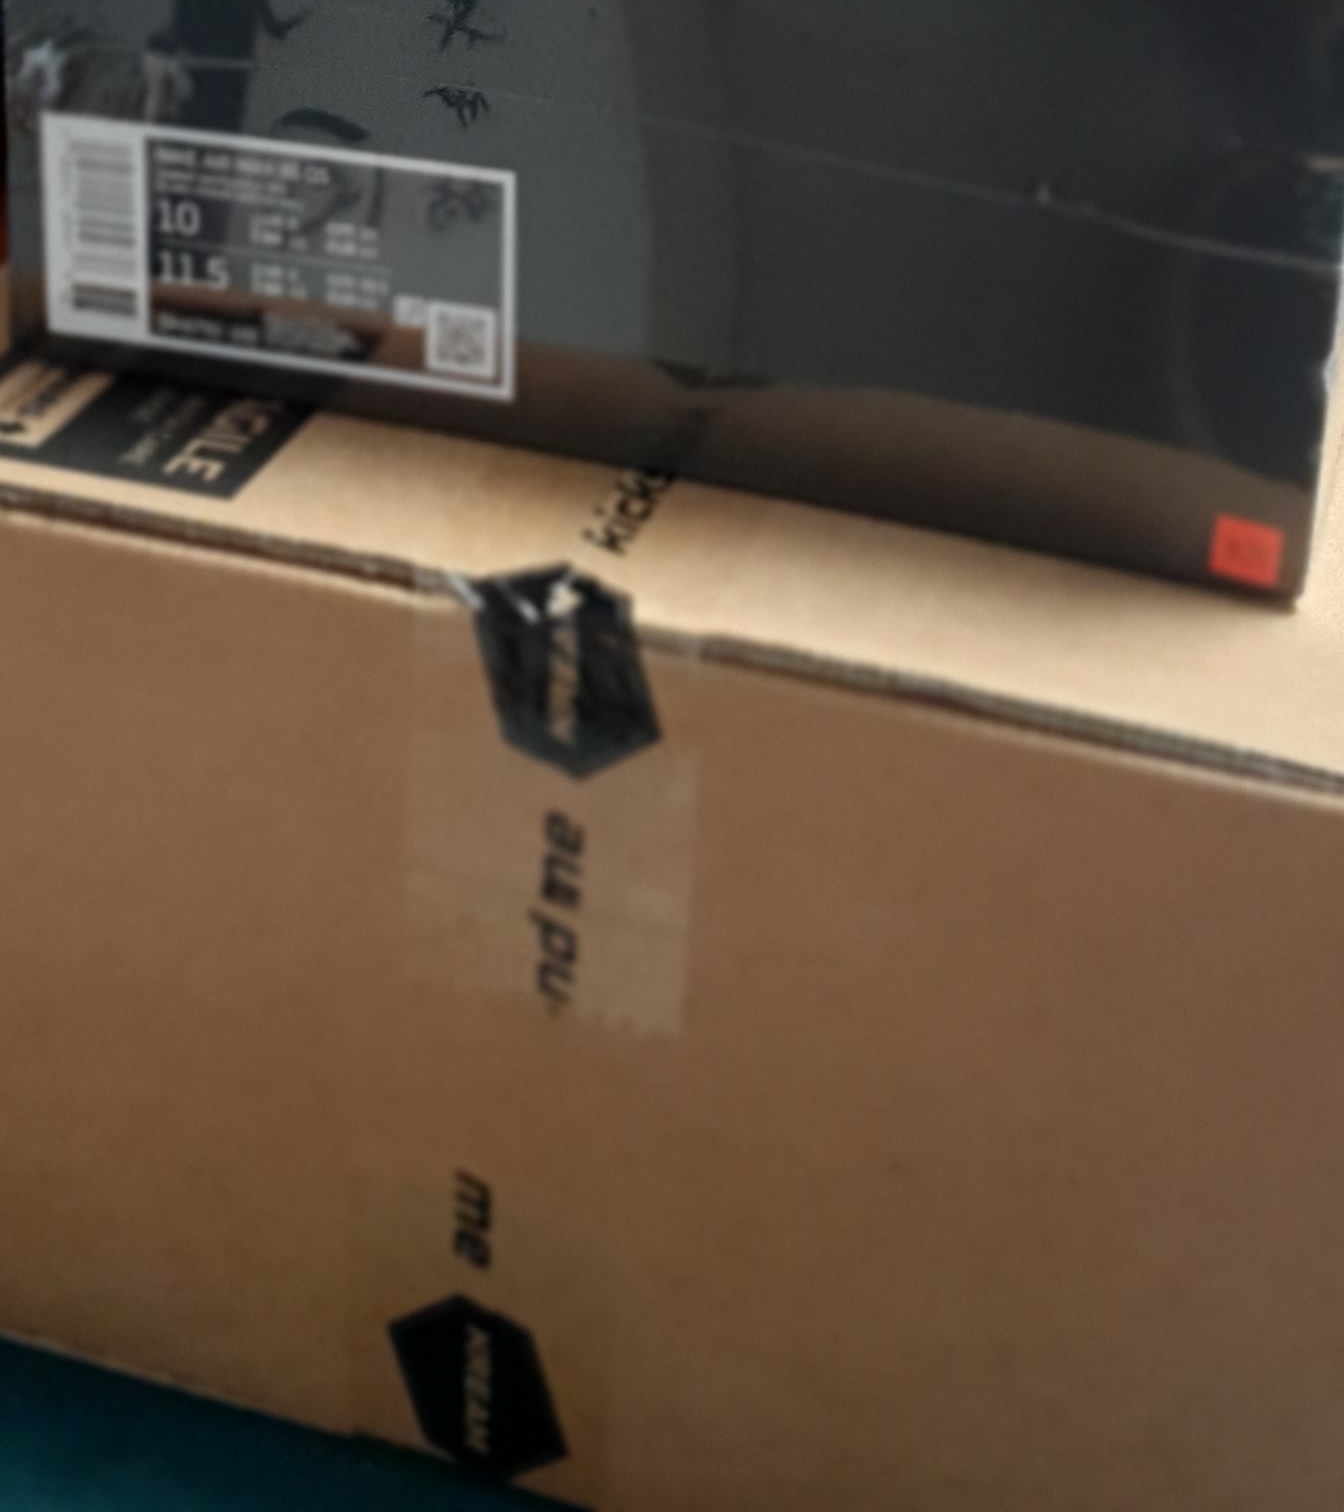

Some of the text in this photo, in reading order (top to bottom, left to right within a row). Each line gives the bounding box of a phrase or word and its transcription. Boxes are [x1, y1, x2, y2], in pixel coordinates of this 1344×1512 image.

[156, 198, 200, 238] 10
[157, 250, 230, 291] 11.5
[453, 1168, 493, 1270] me
